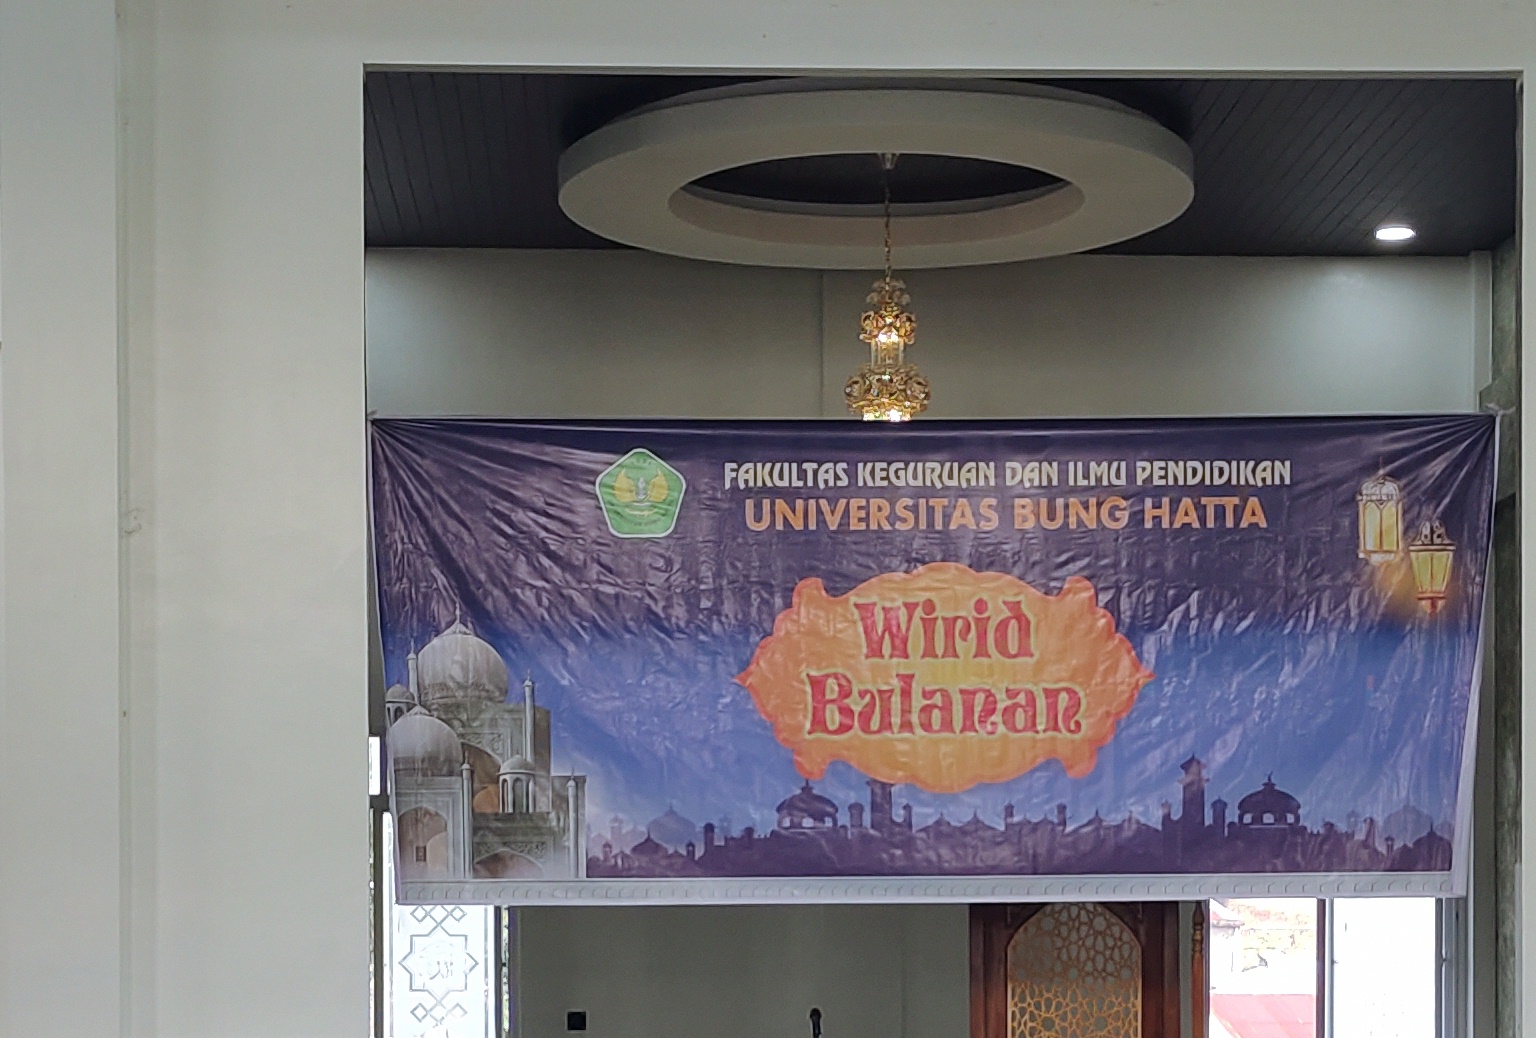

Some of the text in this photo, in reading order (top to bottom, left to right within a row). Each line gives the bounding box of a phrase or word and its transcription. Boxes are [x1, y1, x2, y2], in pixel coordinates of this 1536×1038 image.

[724, 459, 1291, 490] FAKULTAS KEGURUAN DAN ILMU PENDIDIKAN
[744, 496, 1268, 532] UNIVERSITAS BUNG HATTA
[851, 597, 1036, 661] Wirid
[805, 671, 1083, 736] Bulanan
